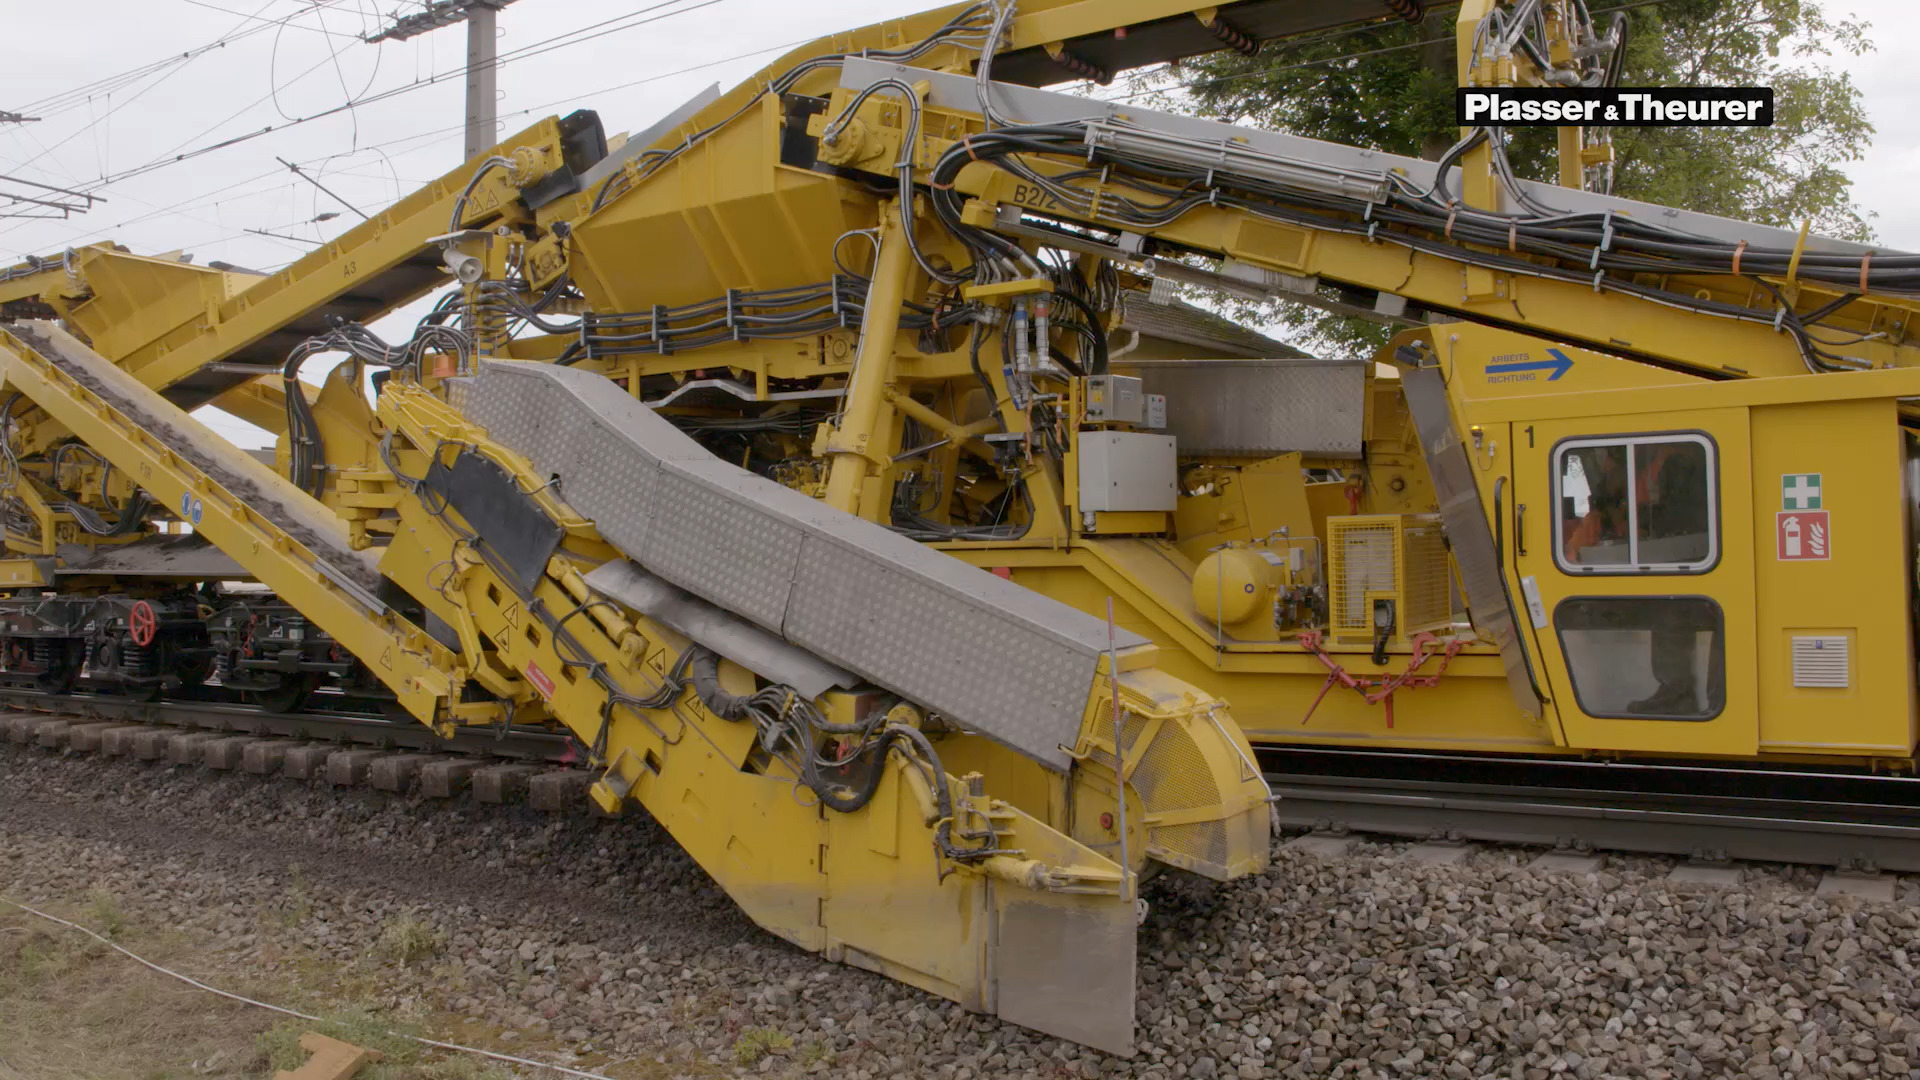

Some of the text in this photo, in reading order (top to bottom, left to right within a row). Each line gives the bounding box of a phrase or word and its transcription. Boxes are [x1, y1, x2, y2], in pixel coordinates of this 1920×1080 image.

[343, 261, 357, 278] A3
[1490, 353, 1530, 364] ARBEITS
[1487, 373, 1536, 384] RICHTUNG
[1524, 425, 1535, 449] 1
